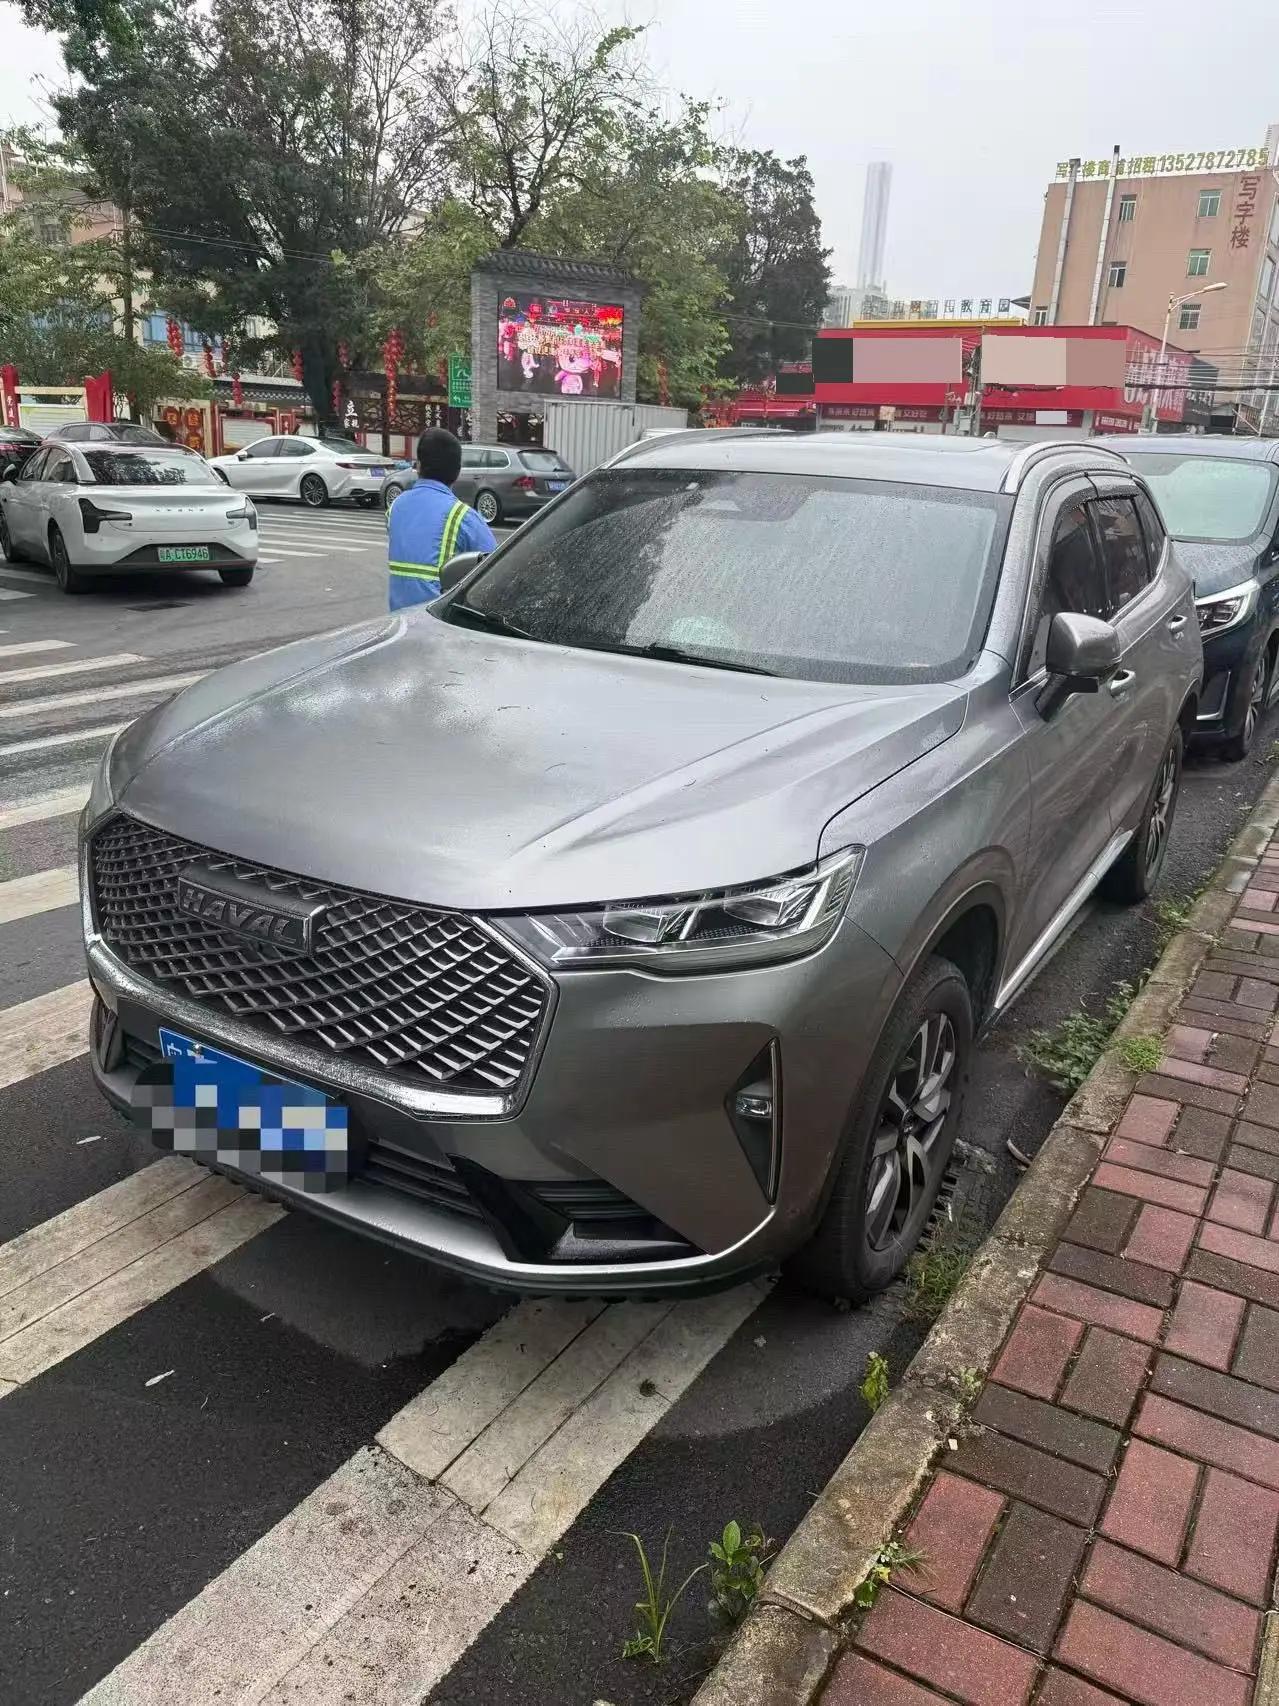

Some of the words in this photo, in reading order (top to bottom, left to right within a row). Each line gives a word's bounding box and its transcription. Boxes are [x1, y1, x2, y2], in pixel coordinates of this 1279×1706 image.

[1230, 176, 1260, 248] 写字楼
[183, 888, 297, 944] HAVAL
